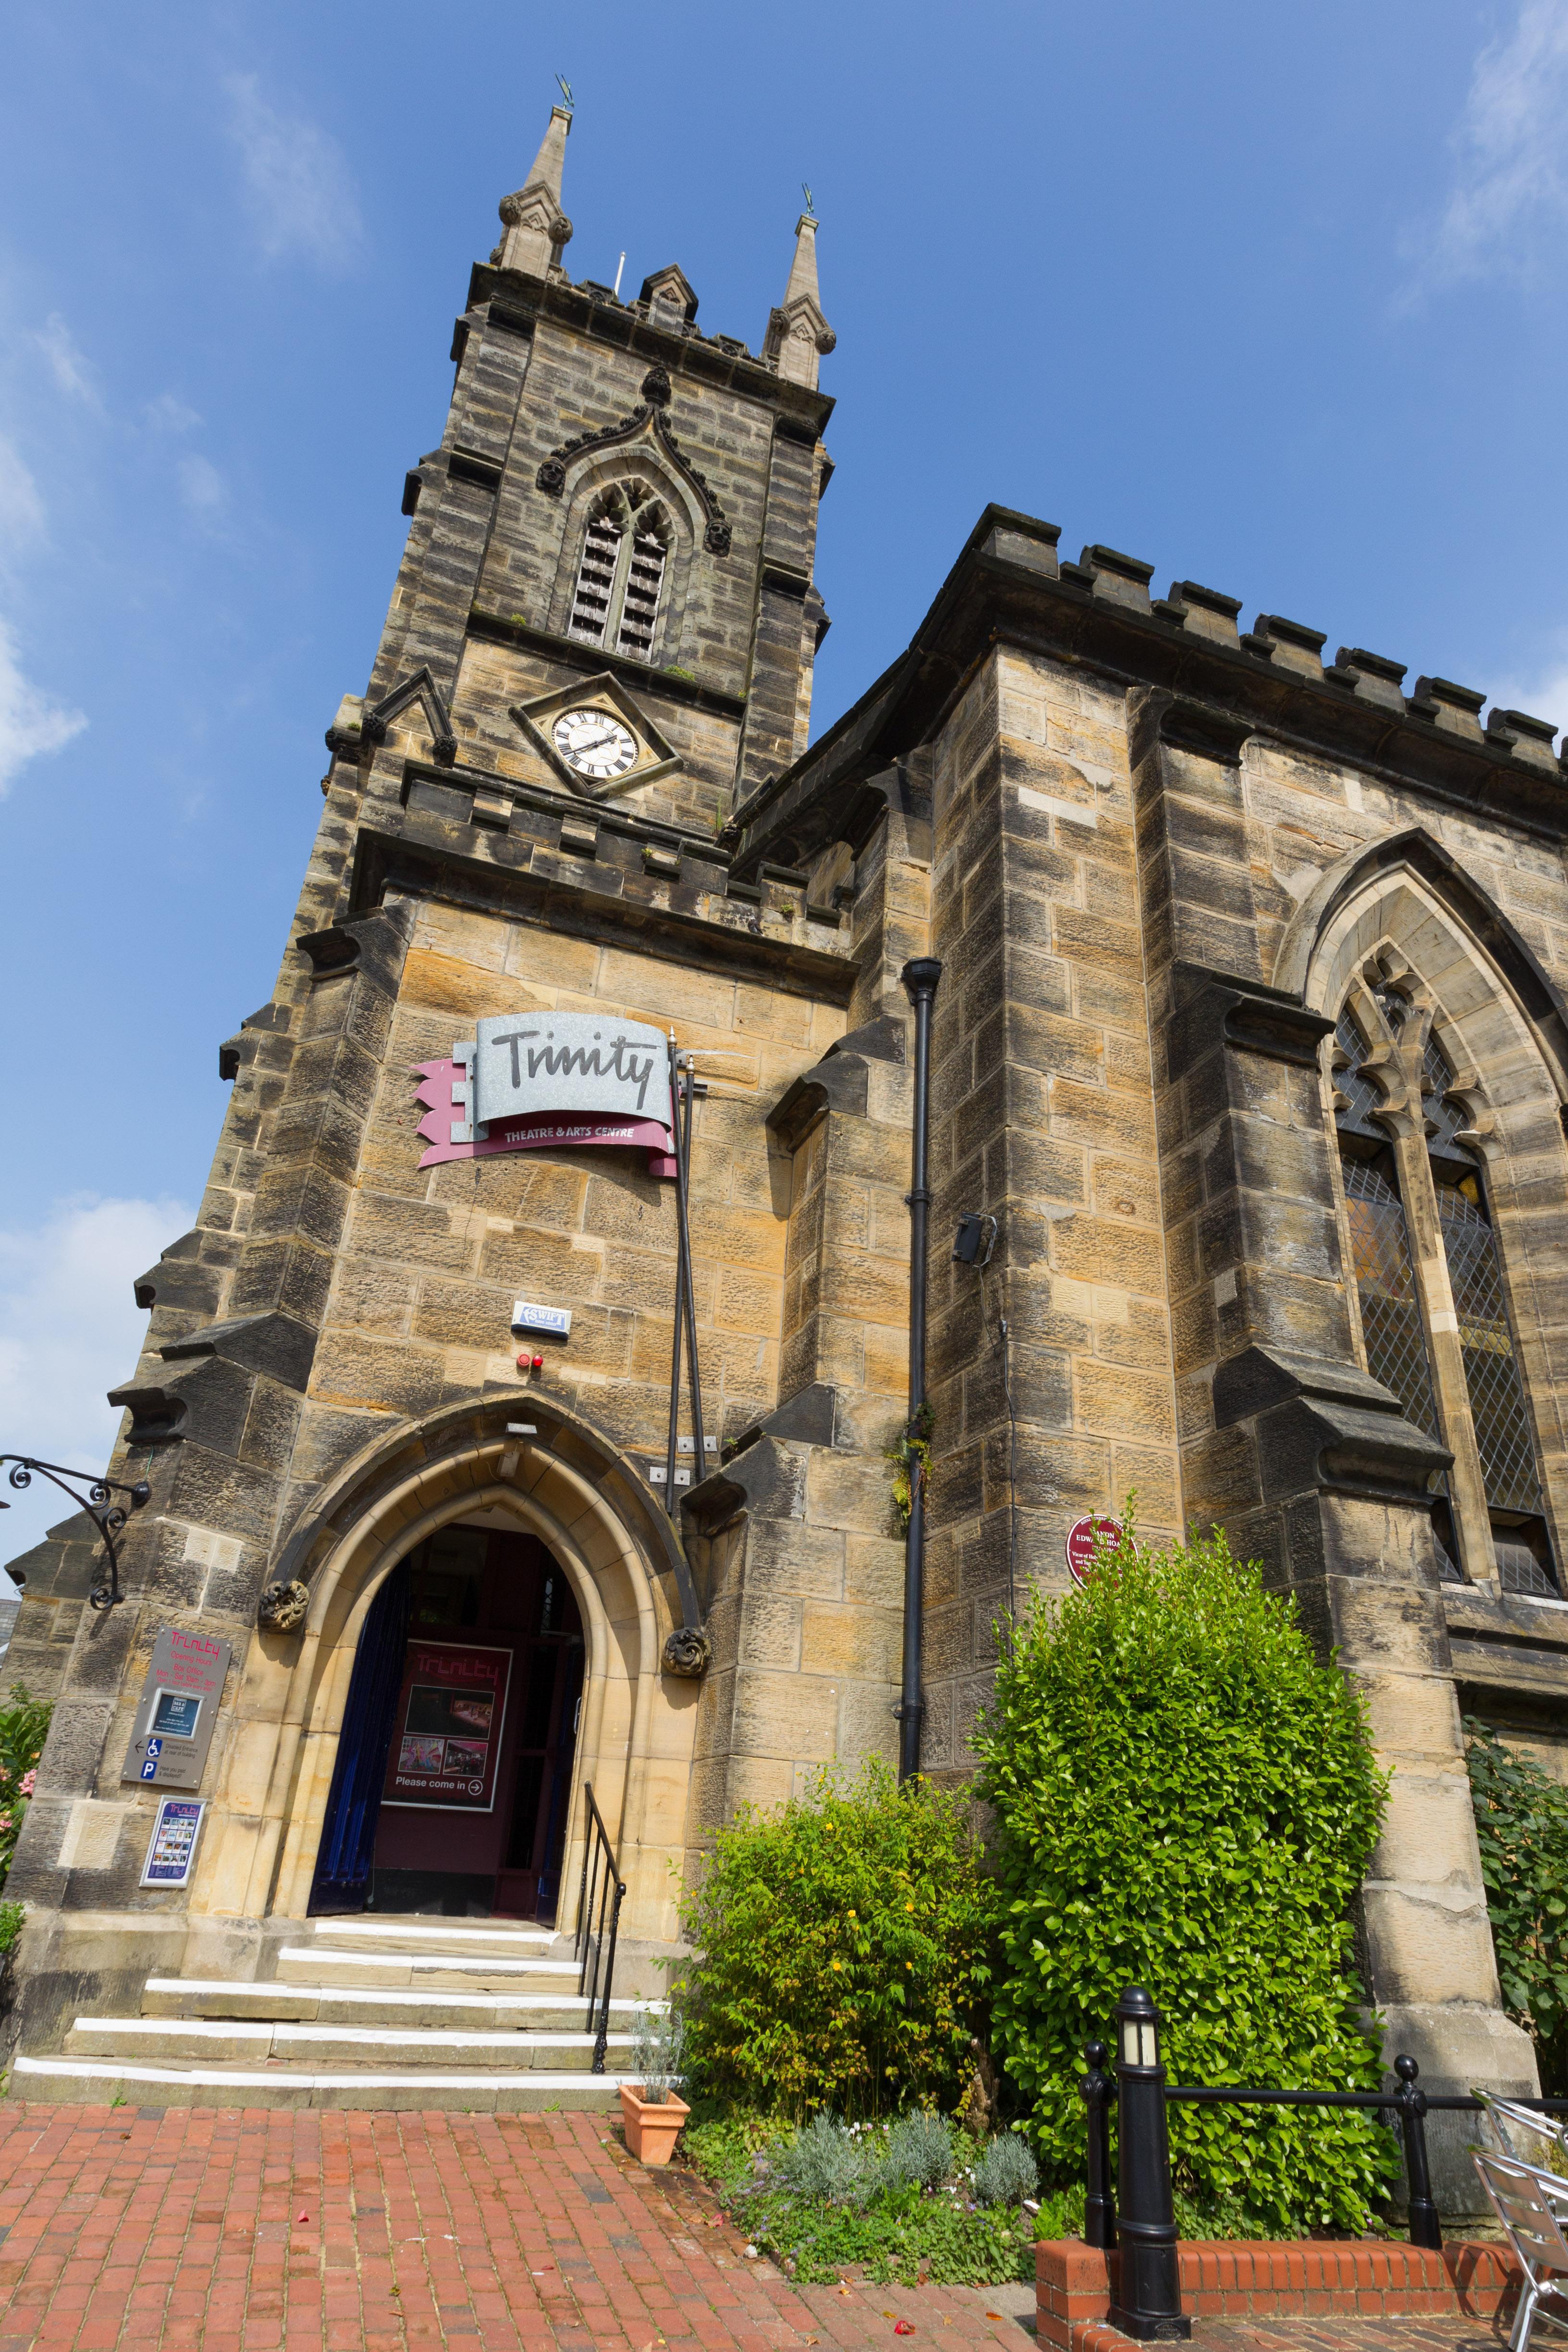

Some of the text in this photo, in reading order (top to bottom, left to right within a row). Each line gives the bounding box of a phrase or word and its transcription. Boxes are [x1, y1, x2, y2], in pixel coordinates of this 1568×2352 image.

[491, 1030, 661, 1110] Trinity
[505, 1127, 634, 1142] THEATRE & ARTS CENTRE
[529, 1309, 564, 1325] SWIFT
[172, 1631, 220, 1661] Trinity
[171, 1651, 212, 1666] Opening Hours
[156, 1669, 168, 1677] Mon
[186, 1675, 200, 1684] 10am
[186, 1666, 204, 1676] Office
[417, 1654, 499, 1686] Trinity
[143, 1763, 154, 1776] P
[395, 1776, 466, 1790] Please come in
[171, 1804, 199, 1817] Trinity
